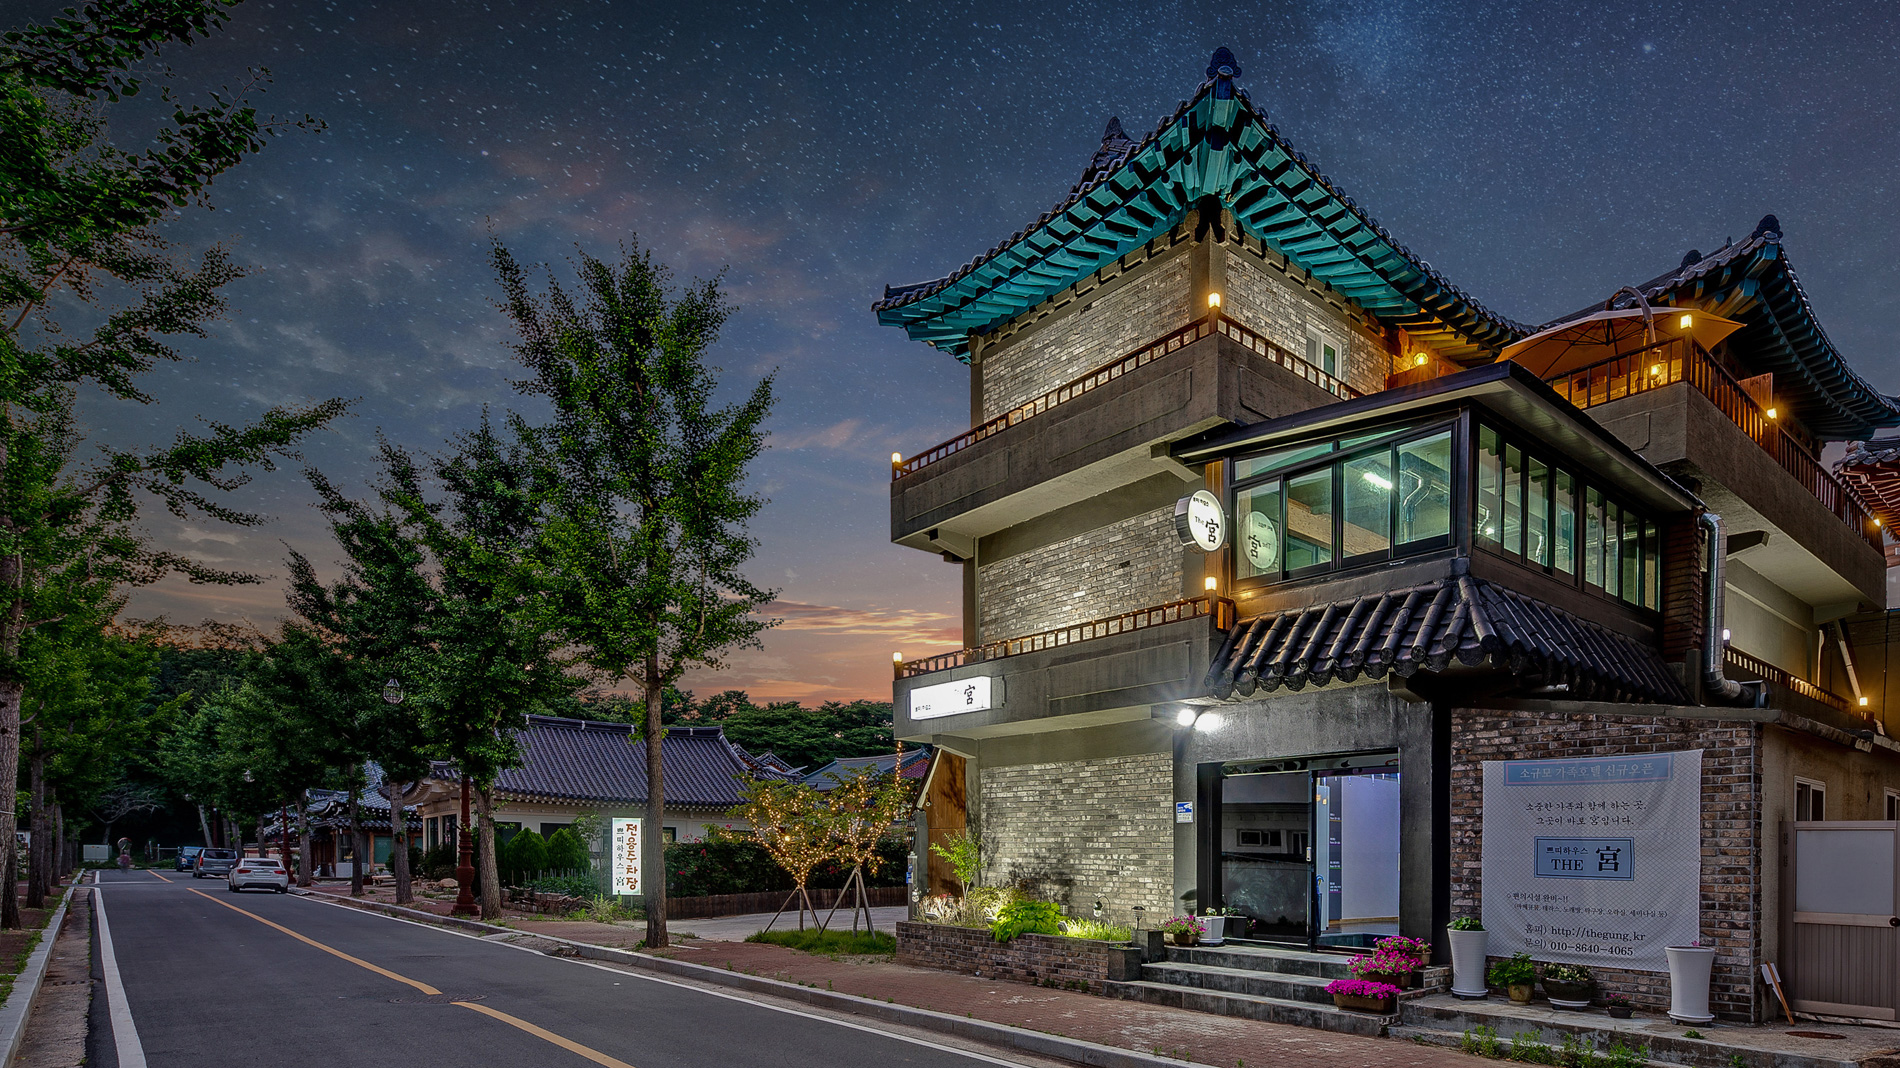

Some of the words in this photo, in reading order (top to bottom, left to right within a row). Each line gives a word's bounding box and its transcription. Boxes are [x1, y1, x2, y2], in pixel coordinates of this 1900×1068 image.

[1520, 767, 1552, 779] 소규모
[1556, 765, 1602, 778] 가족호텔
[1605, 762, 1654, 776] 신규오픈
[1526, 801, 1553, 812] 소중한
[1556, 801, 1583, 811] 가족과
[1587, 801, 1606, 812] 함께
[1610, 800, 1630, 811] 하는
[1633, 800, 1647, 810] 곳.
[1536, 816, 1563, 826] 그곳이
[1567, 816, 1586, 825] 바로
[626, 823, 638, 890] 전용주차장
[1551, 858, 1584, 871] THE
[1595, 845, 1622, 872] 宮
[1513, 893, 1541, 902] 편의시설
[1525, 923, 1547, 935] 홈피)
[1551, 925, 1646, 942] http://thegung.kr
[1524, 938, 1547, 950] 문의)
[1550, 941, 1633, 957] 010-8640-4065
